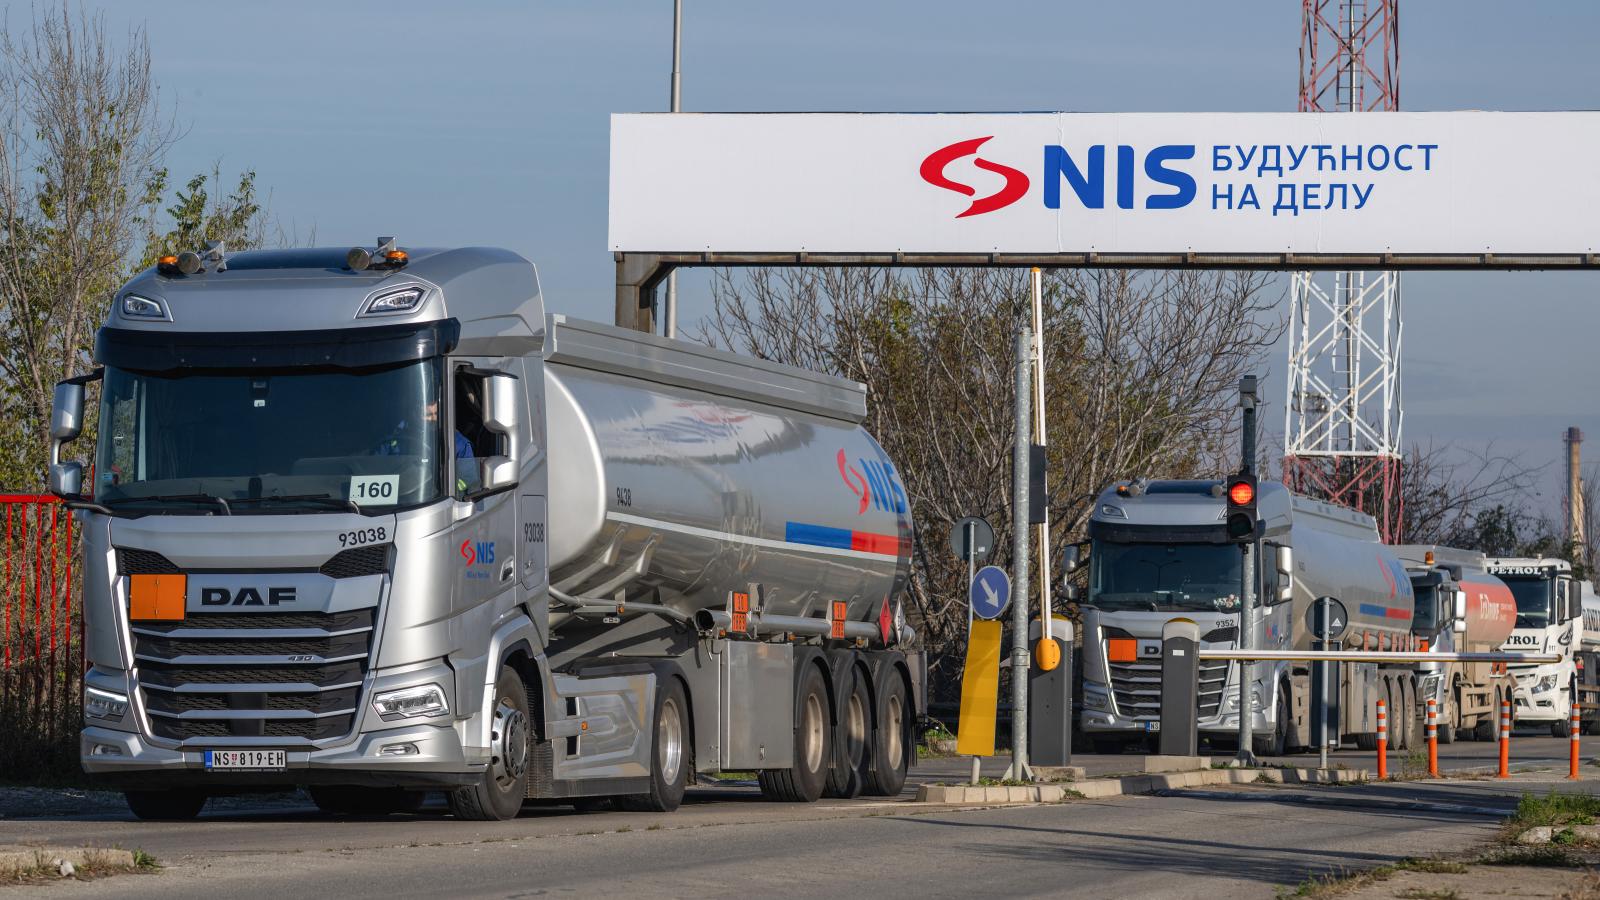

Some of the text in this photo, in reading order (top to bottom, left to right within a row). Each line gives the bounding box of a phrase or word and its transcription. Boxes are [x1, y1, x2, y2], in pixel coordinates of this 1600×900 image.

[1211, 144, 1439, 178] БУДУЋНОСТ
[1043, 144, 1197, 210] NIS
[1211, 183, 1375, 217] НА ДЕЛУ
[357, 481, 393, 498] 160
[858, 457, 906, 514] NIS
[616, 486, 632, 507] 9438
[338, 526, 387, 548] 93038
[524, 522, 545, 543] 93038
[476, 541, 495, 564] NIS
[1490, 566, 1542, 576] PETROL
[201, 587, 298, 606] DAF
[1215, 619, 1235, 628] 9352
[1506, 635, 1540, 645] TROL
[214, 752, 230, 766] NS
